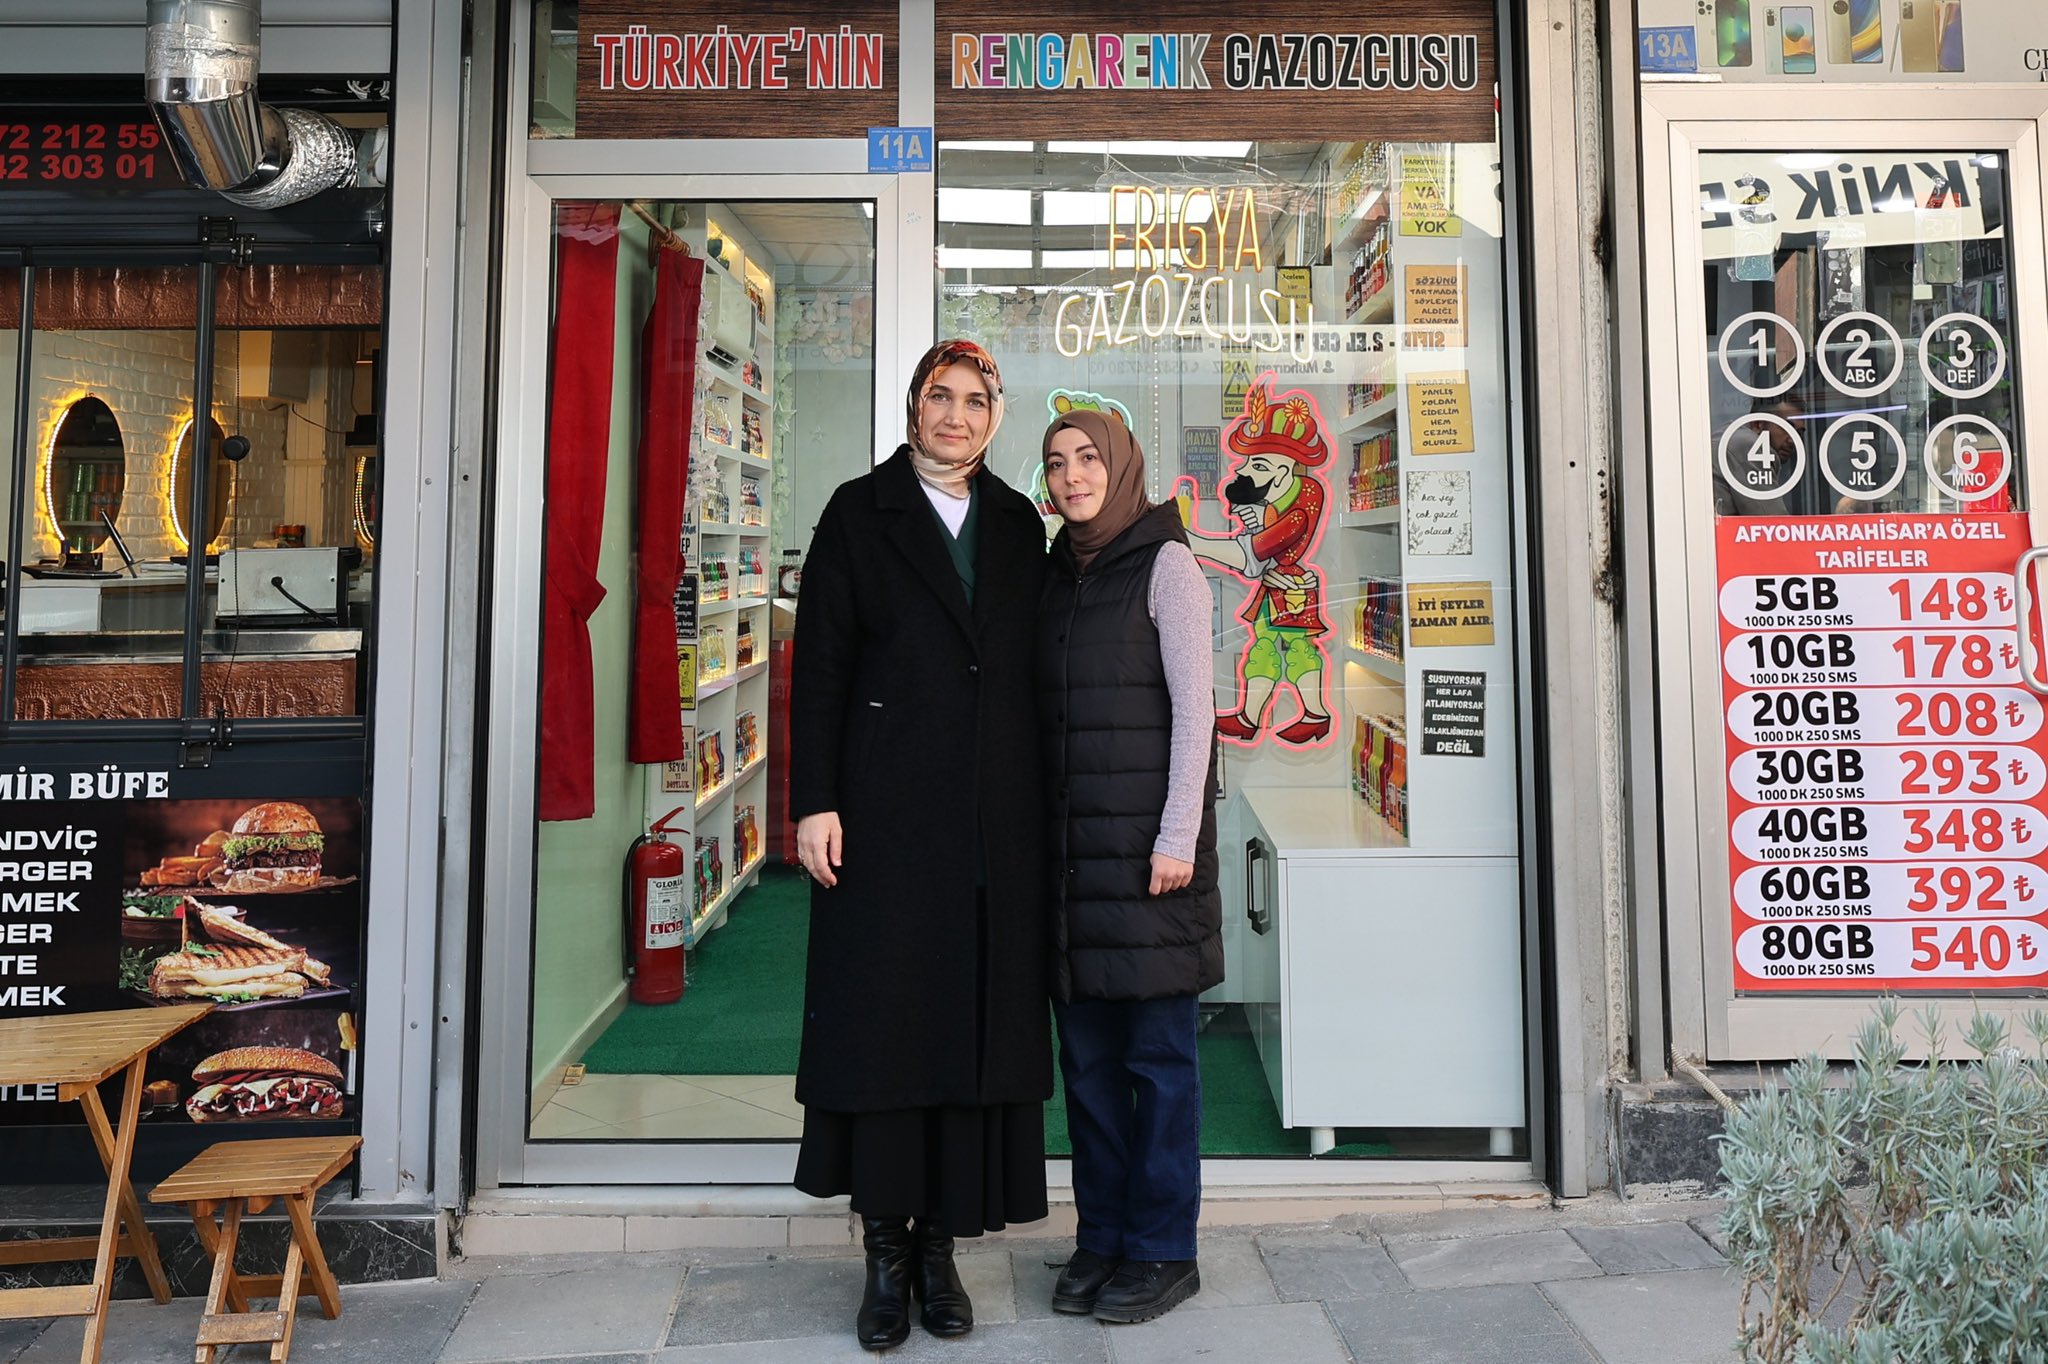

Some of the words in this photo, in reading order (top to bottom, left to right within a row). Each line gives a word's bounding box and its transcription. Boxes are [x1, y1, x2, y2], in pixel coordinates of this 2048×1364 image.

[1643, 33, 1688, 58] 13A
[594, 24, 883, 90] TÜRKİYE'NİN
[952, 33, 1212, 90] RENGARENK
[1223, 33, 1478, 91] GAZOZCUSU
[41, 125, 106, 150] 212
[117, 125, 160, 149] 55
[878, 134, 924, 159] 11A
[40, 154, 104, 180] 303
[116, 154, 155, 179] 01
[1406, 202, 1428, 210] AMA
[1108, 185, 1263, 272] FRIGYA
[1415, 220, 1447, 233] YOK
[1415, 276, 1458, 286] SÖZÜNÜ
[1055, 273, 1314, 365] GAZOZCUSU
[1748, 328, 1768, 367] 1
[1845, 329, 1872, 367] 2
[1948, 329, 1975, 368] 3
[1845, 369, 1876, 383] ABC
[1947, 369, 1976, 384] DEF
[1421, 398, 1457, 406] YOLDAN
[1747, 430, 1775, 469] 4
[1850, 432, 1877, 471] 5
[1953, 432, 1980, 471] 6
[1747, 471, 1773, 486] GHI
[1848, 471, 1877, 487] JKL
[1952, 473, 1986, 487] MNO
[1951, 518, 2006, 540] ÖZEL
[1815, 546, 1929, 569] TARİFELER
[1755, 577, 1839, 612] 5GB
[1418, 597, 1436, 611] İYİ
[1440, 600, 1485, 613] ŞEYLER
[1410, 617, 1458, 628] ZAMAN
[1744, 615, 1774, 627] 1000
[1777, 615, 1795, 626] DK
[1798, 615, 1821, 626] 250
[1824, 614, 1854, 626] SMS
[1747, 633, 1856, 669] 10GB
[1428, 674, 1482, 685] SUSUYORSAK
[1750, 673, 1779, 684] 1000
[1781, 672, 1800, 684] DK
[1802, 672, 1825, 683] 250
[1828, 672, 1857, 683] SMS
[1453, 689, 1472, 697] LAFA
[1425, 699, 1484, 710] ATLAMIYORSAK
[1752, 691, 1860, 727] 20GB
[1754, 731, 1784, 743] 1000
[1786, 730, 1804, 742] DK
[1806, 730, 1829, 741] 250
[1832, 729, 1861, 741] SMS
[1436, 740, 1474, 754] DEĞİL
[1756, 748, 1864, 785] 30GB
[69, 765, 169, 799] BÜFE
[1757, 789, 1787, 801] 1000
[1790, 789, 1808, 800] DK
[1810, 788, 1833, 800] 250
[1836, 788, 1865, 799] SMS
[1758, 807, 1867, 843] 40GB
[1759, 848, 1789, 859] 1000
[1793, 847, 1811, 858] DK
[1814, 847, 1837, 858] 250
[1839, 846, 1868, 857] SMS
[1760, 865, 1871, 901] 60GB
[1761, 906, 1793, 918] 1000
[1795, 905, 1813, 917] DK
[1816, 905, 1840, 916] 250
[1843, 905, 1872, 916] SMS
[0, 924, 52, 944] ER
[1762, 924, 1874, 961] 80GB
[1762, 965, 1795, 976] 1000
[1798, 964, 1817, 975] DK
[1819, 964, 1843, 975] 250
[1846, 964, 1875, 975] SMS
